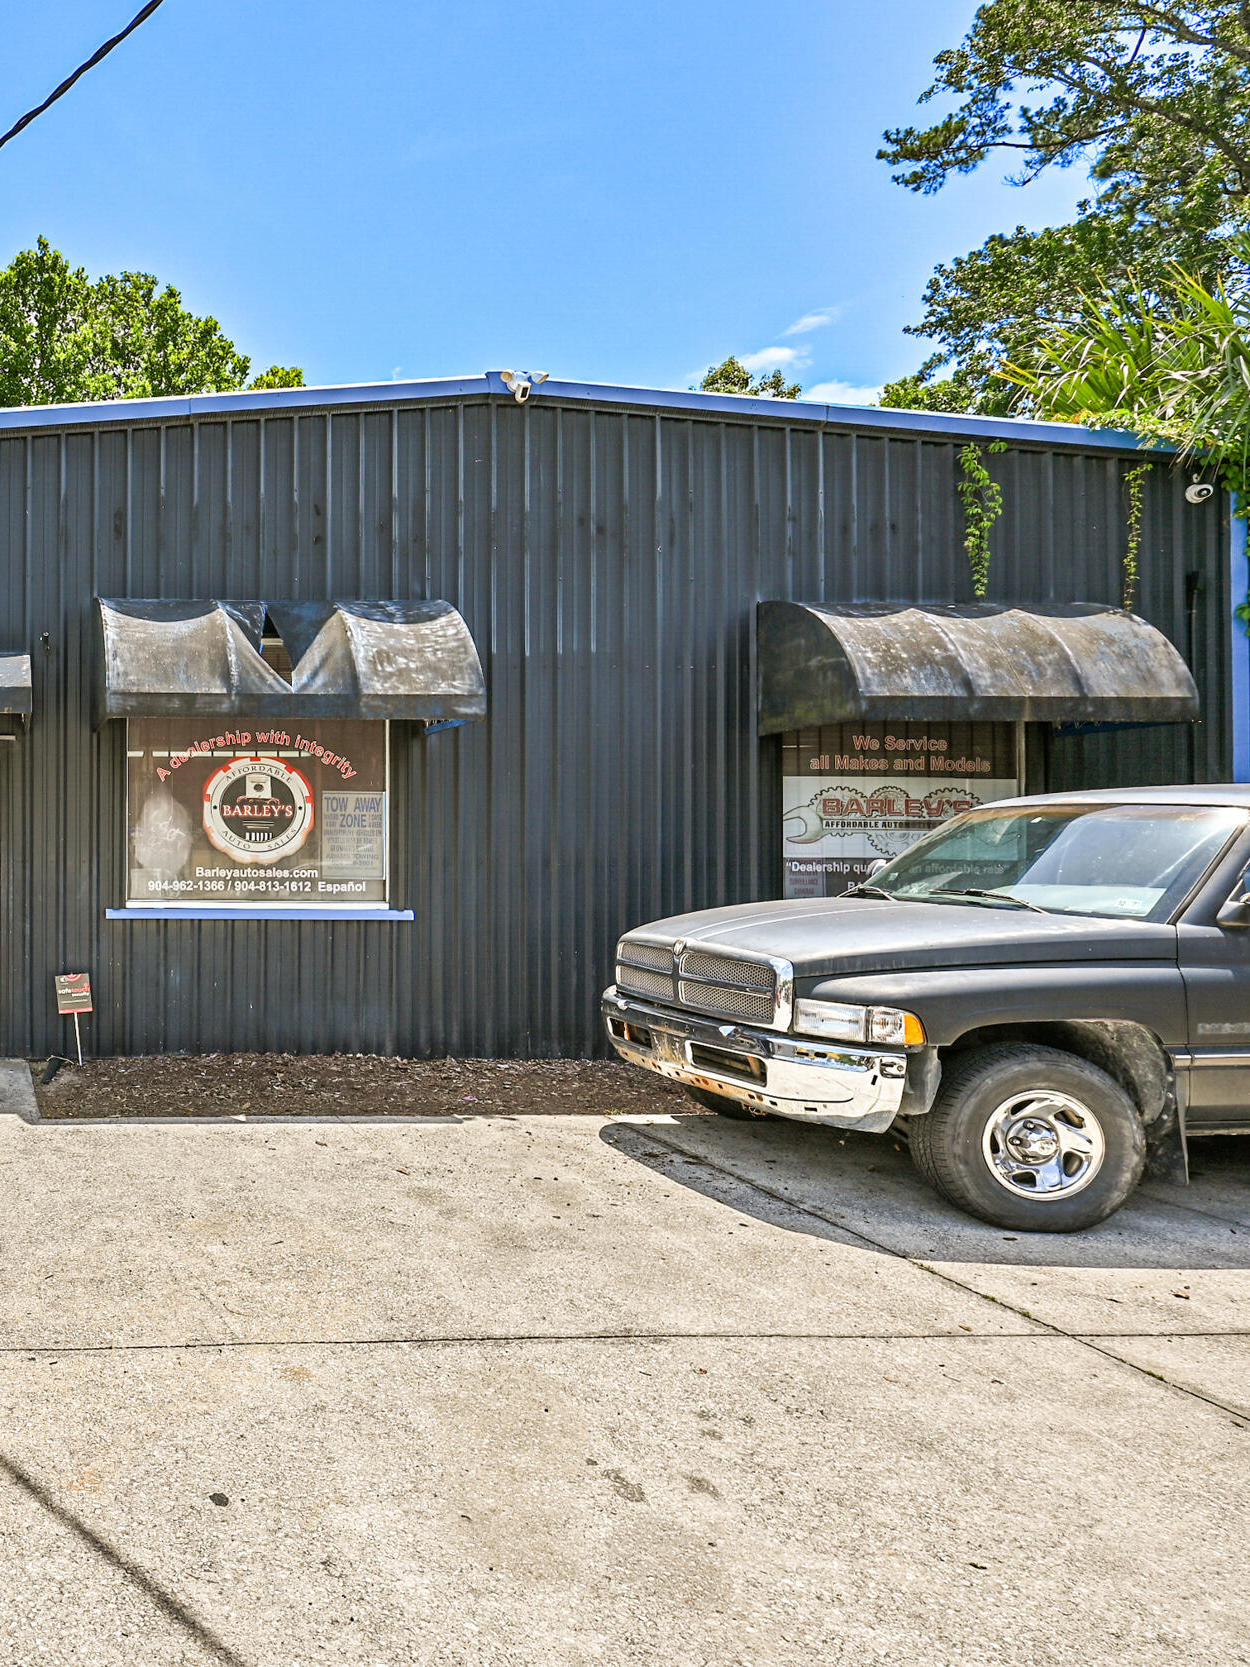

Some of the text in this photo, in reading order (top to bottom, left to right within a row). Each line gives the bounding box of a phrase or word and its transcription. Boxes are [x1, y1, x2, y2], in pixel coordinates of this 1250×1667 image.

[852, 735, 948, 751] We Service
[156, 729, 357, 783] A dealership with integrity
[809, 754, 991, 772] all Makes and Models
[225, 765, 293, 784] AFFORDABLE
[222, 804, 294, 817] BARLEY'S
[325, 796, 382, 813] TOW AWAY
[822, 798, 971, 817] BARLEY'S
[340, 813, 367, 828] ZONE
[825, 820, 879, 829] AFFORDABLE
[221, 828, 297, 850] AUTO SALES
[195, 866, 318, 879] Barleyautosales.com
[148, 880, 224, 891] 904-962-1366
[234, 880, 311, 892] 904-813-1612
[317, 881, 366, 892] Español
